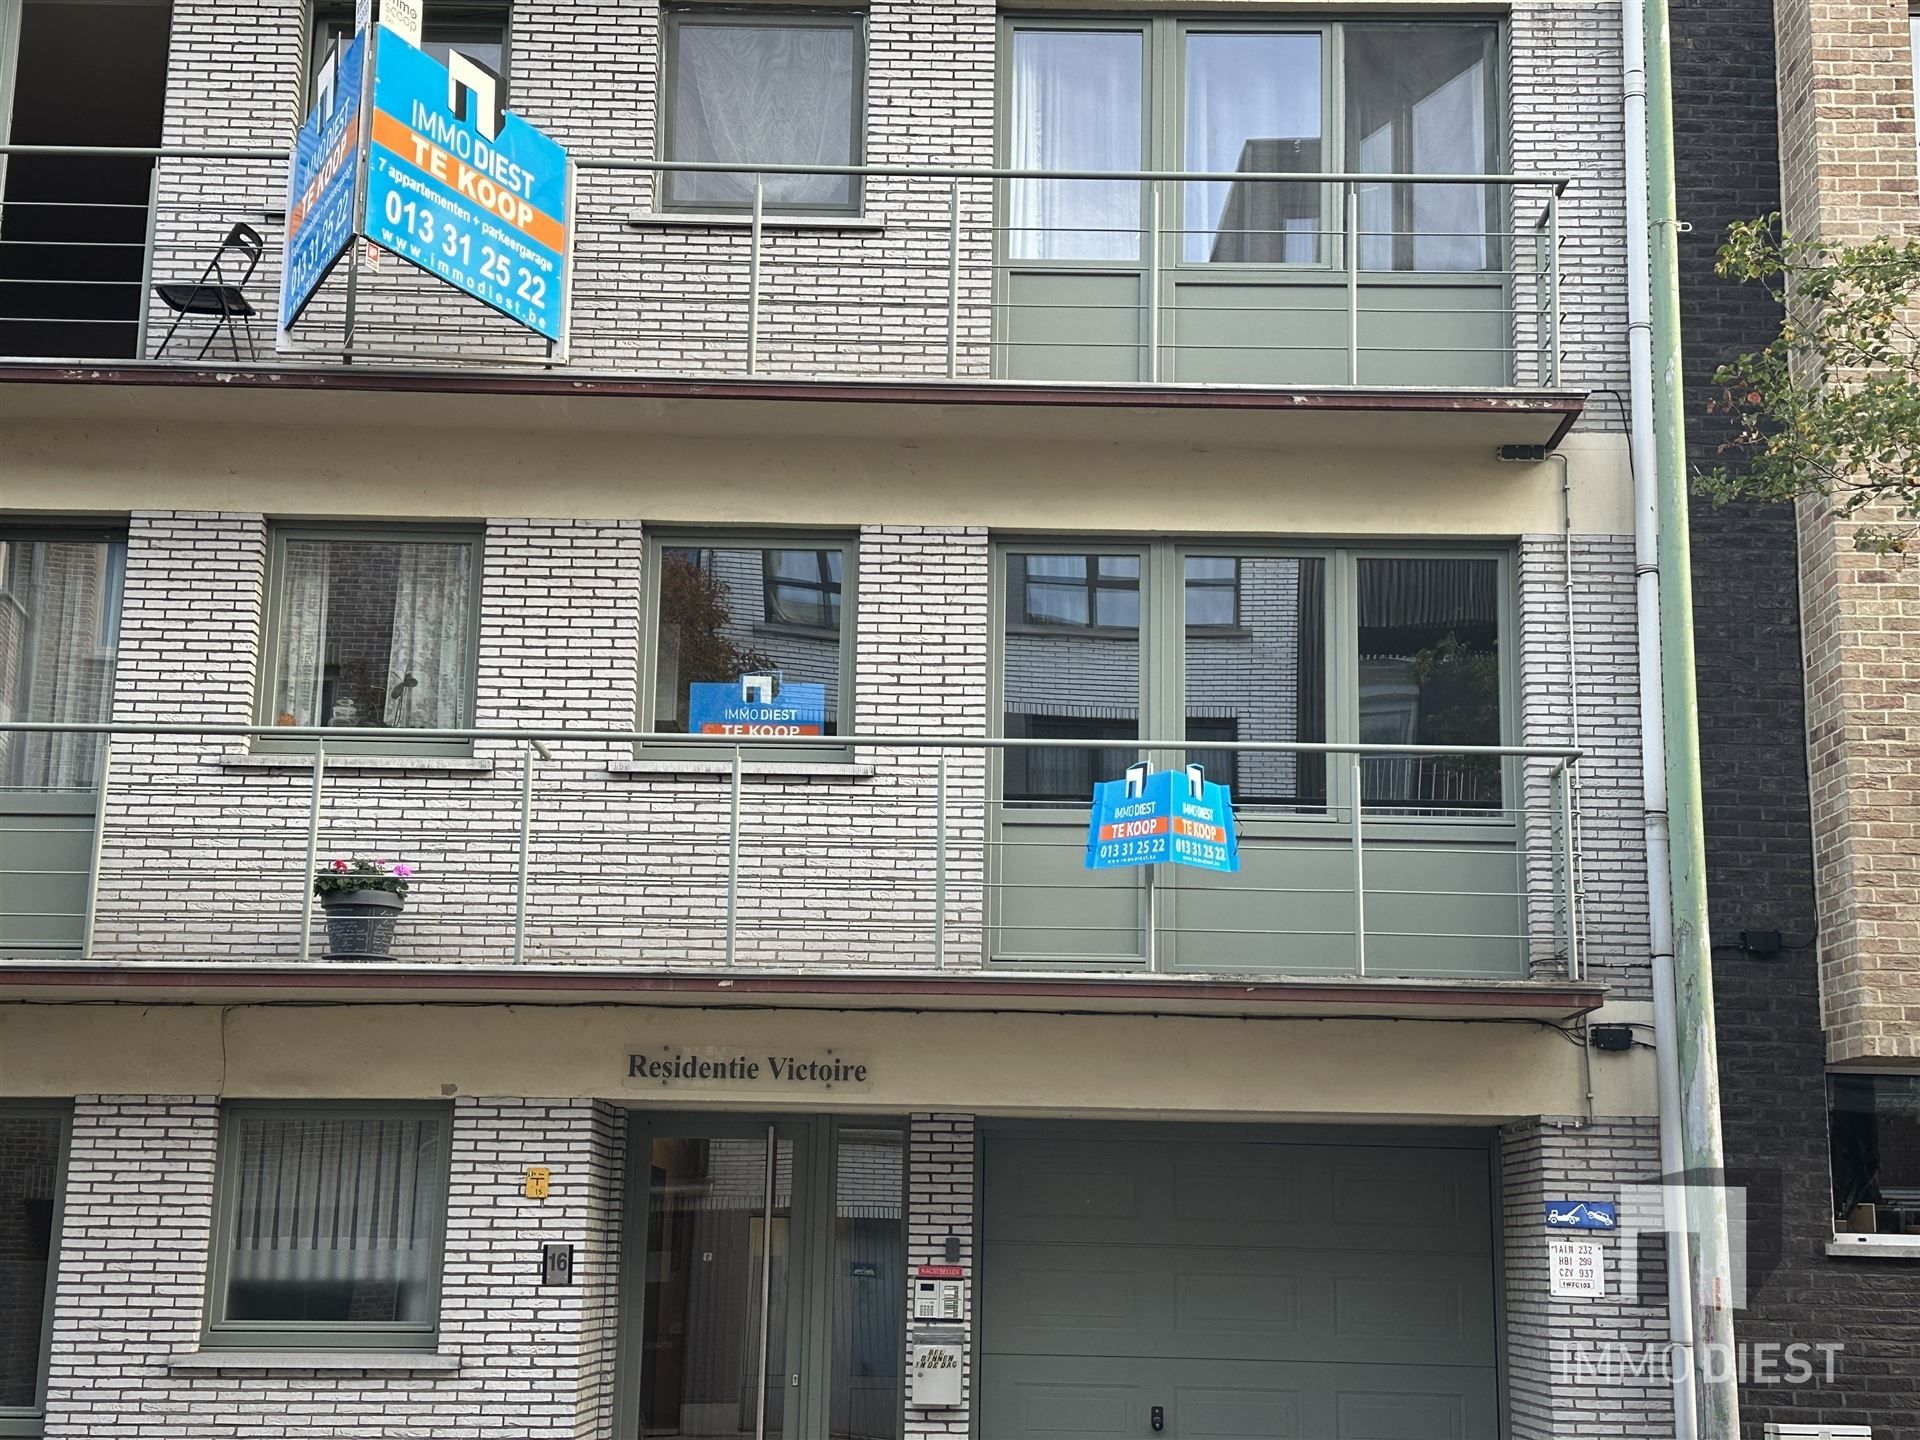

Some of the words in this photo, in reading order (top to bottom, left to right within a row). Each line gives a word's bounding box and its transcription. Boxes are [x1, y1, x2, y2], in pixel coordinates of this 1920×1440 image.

[325, 97, 351, 154] DIEST
[412, 98, 471, 159] IMMO
[473, 138, 536, 200] DIEST
[302, 187, 316, 220] TE
[316, 131, 348, 195] KOOP
[410, 133, 448, 182] TE
[457, 164, 534, 229] KOOP
[377, 157, 387, 172] 7
[388, 165, 471, 223] appartementen
[481, 221, 553, 273] parkeergarage
[290, 248, 307, 297] 013
[308, 234, 320, 271] 31
[321, 211, 335, 254] 25
[335, 189, 349, 233] 22
[385, 190, 434, 244] 013
[442, 223, 471, 267] 31
[479, 245, 511, 288] 25
[516, 266, 546, 310] 22
[381, 227, 546, 329] www.immodiest.be
[724, 708, 758, 720] IMMO
[760, 708, 798, 721] DIEST
[748, 724, 800, 735] KOOP
[1134, 801, 1157, 816] DIEST
[1111, 824, 1125, 839] TE
[1127, 819, 1158, 837] KOOP
[1181, 819, 1193, 836] TE
[1191, 821, 1217, 841] KOOP
[1100, 844, 1119, 858] 013
[1122, 842, 1135, 854] 31
[1136, 840, 1150, 853] 25
[1152, 838, 1165, 852] 22
[1175, 838, 1191, 854] 013
[1191, 841, 1202, 857] 31
[1203, 844, 1215, 859] 25
[1215, 847, 1227, 861] 22
[628, 1054, 760, 1080] Residentie
[768, 1057, 868, 1082] Victoire
[1579, 1246, 1593, 1254] 232
[548, 1252, 568, 1272] 16
[1579, 1269, 1594, 1278] 937
[915, 1361, 927, 1369] IN
[928, 1361, 939, 1369] DE
[940, 1361, 958, 1369] DAG
